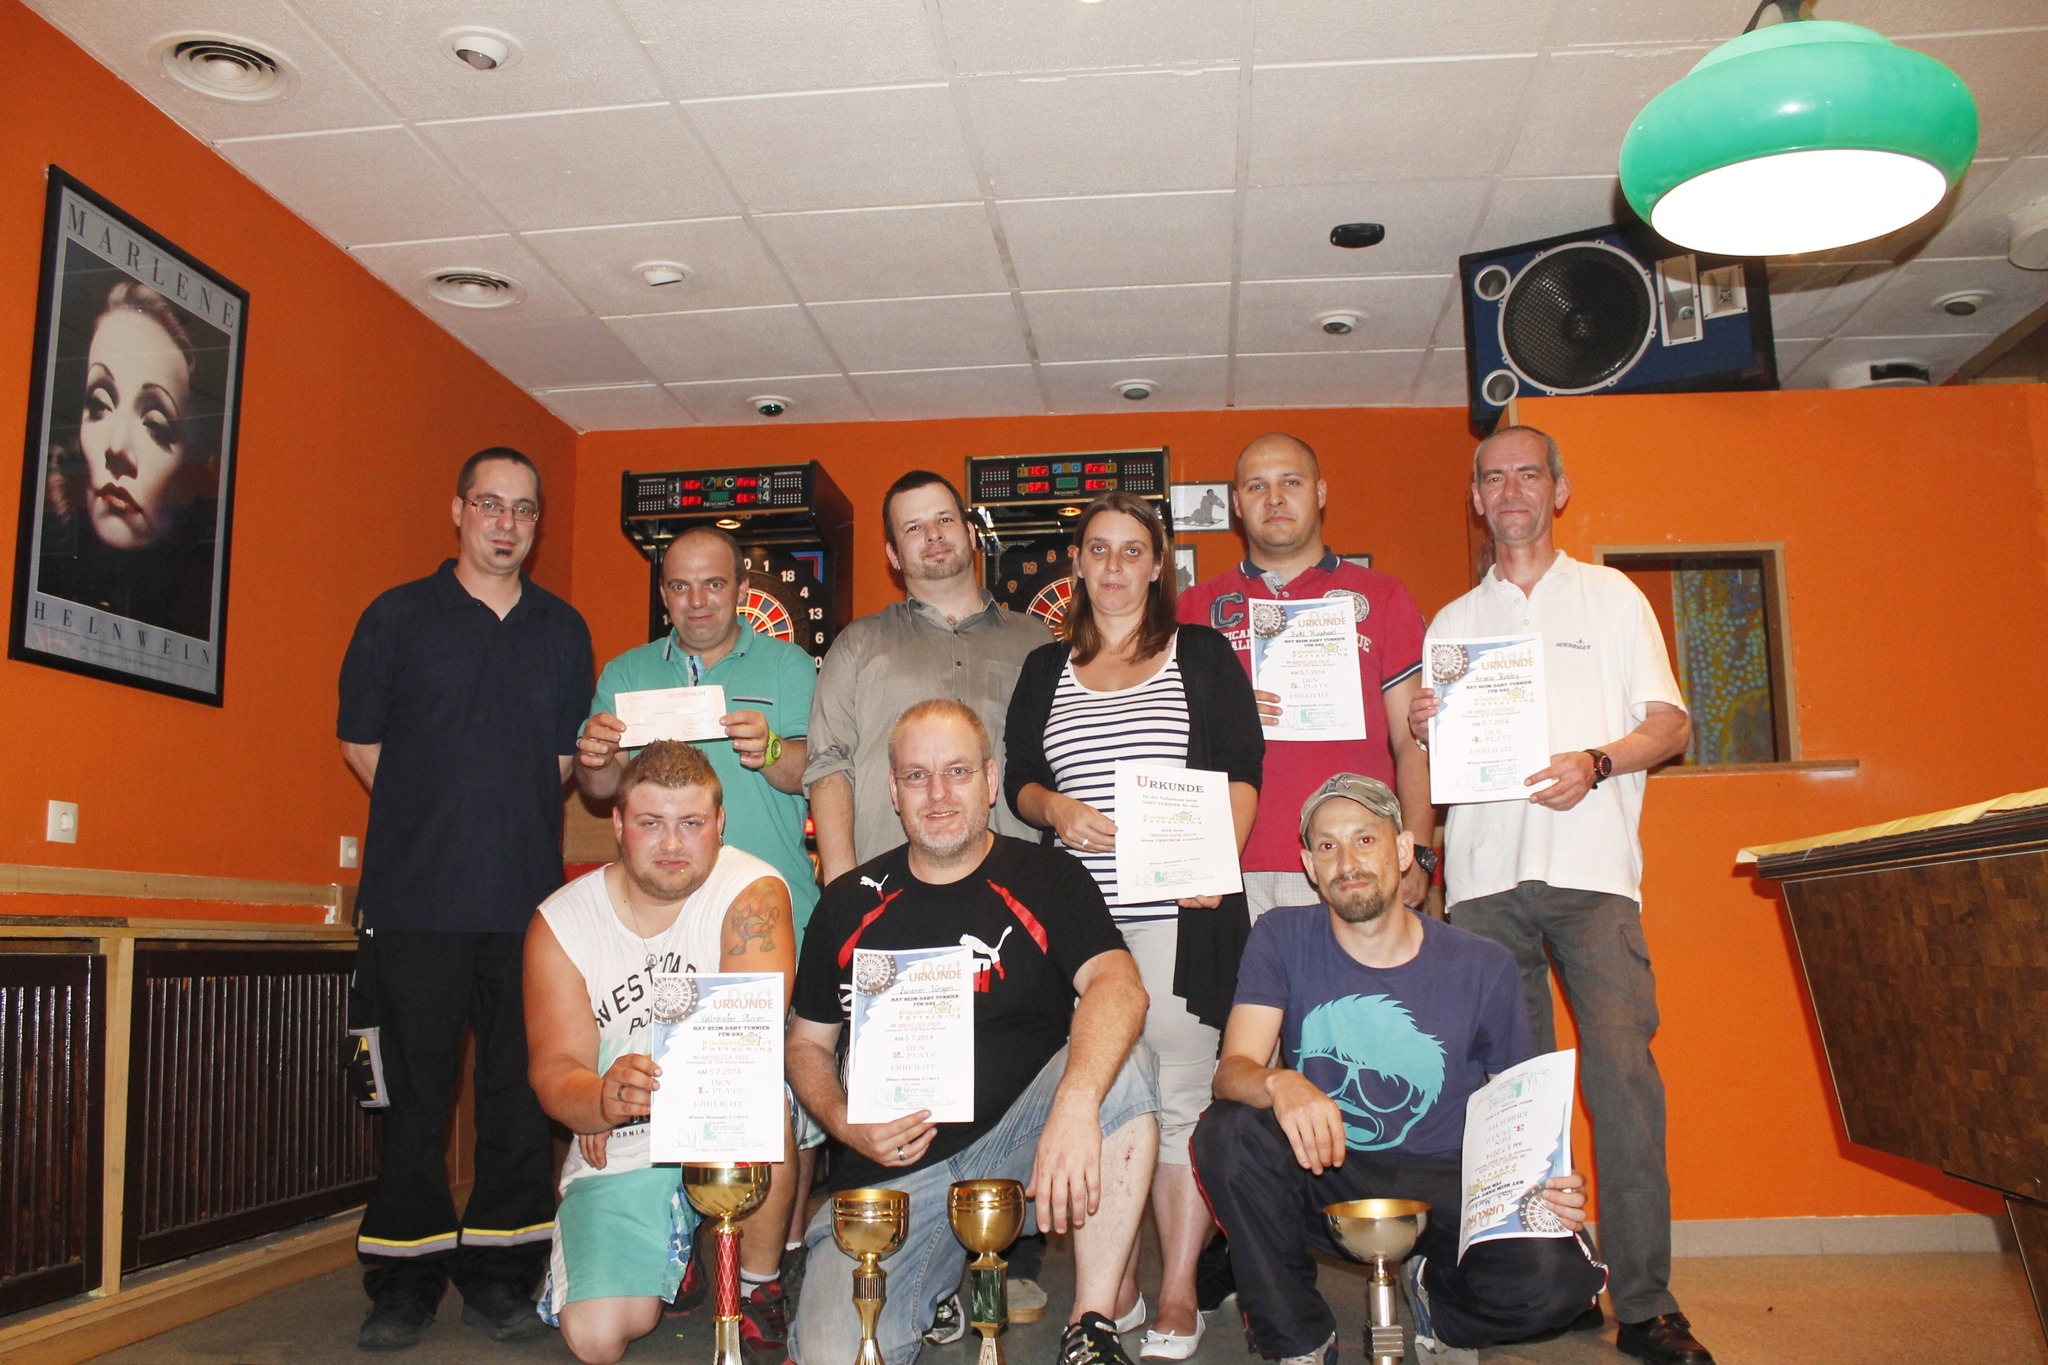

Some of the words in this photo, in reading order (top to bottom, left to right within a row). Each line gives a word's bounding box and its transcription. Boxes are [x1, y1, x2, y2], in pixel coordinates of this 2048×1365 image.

[66, 203, 234, 328] MARLENE
[762, 477, 770, 488] 2
[673, 496, 680, 507] 3
[762, 491, 770, 501] 4
[763, 560, 770, 572] 1
[1022, 561, 1037, 574] 12
[781, 570, 795, 582] 18
[800, 587, 809, 598] 4
[1007, 580, 1017, 593] 9
[808, 608, 823, 620] 13
[1210, 592, 1244, 629] C
[1298, 617, 1347, 628] URKUNDE
[34, 601, 210, 665] HELNWEIN
[815, 632, 824, 644] 6
[1481, 658, 1534, 670] URKUNDE
[1136, 775, 1204, 793] URKUNDE
[909, 969, 962, 982] URKUNDE
[728, 987, 773, 1000] Dart
[713, 999, 774, 1010] URKUNDE
